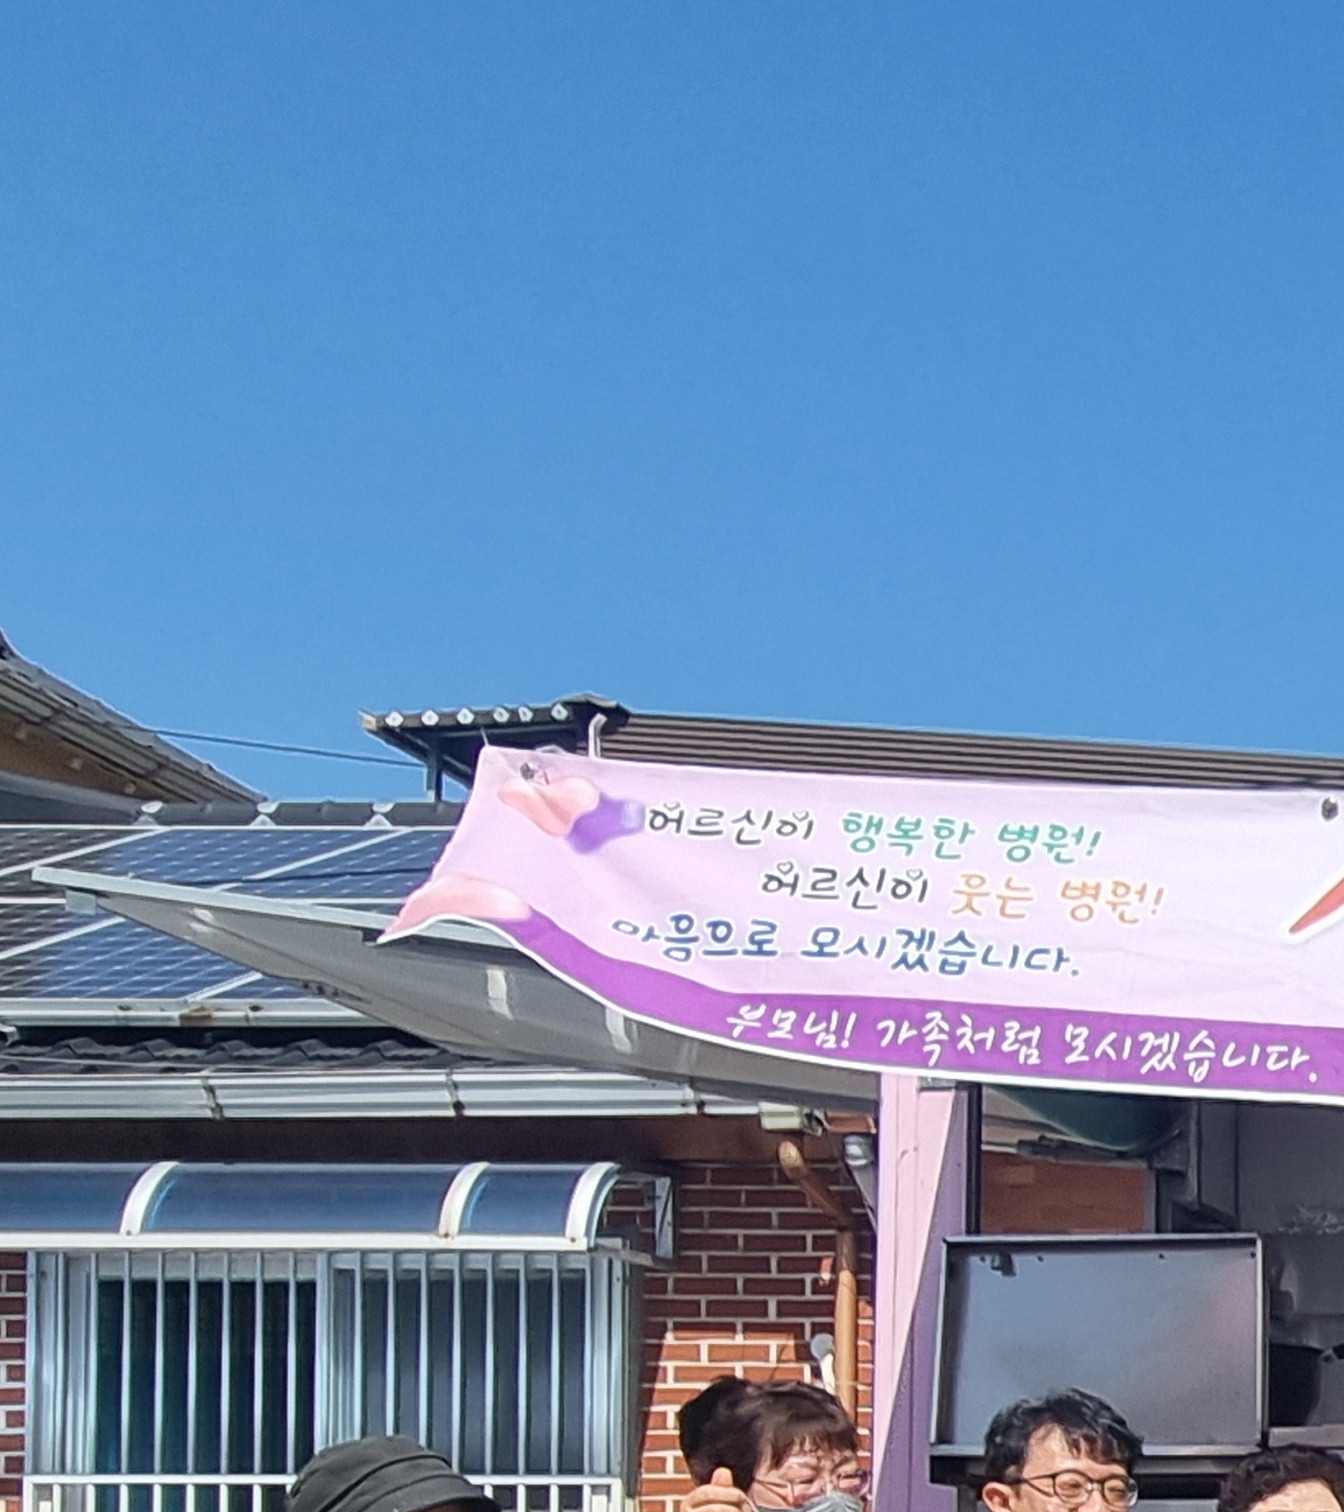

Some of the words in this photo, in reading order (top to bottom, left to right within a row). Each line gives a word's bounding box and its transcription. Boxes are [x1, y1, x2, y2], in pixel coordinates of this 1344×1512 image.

[648, 801, 814, 846] 어르신이
[841, 811, 974, 858] 행복한
[996, 822, 1102, 865] 병원!
[760, 860, 930, 910] 어르신이
[951, 871, 1035, 917] 웃는
[1059, 879, 1164, 924] 병원!
[800, 926, 1081, 977] 모시겠습니다.
[726, 1004, 856, 1051] 부모님!
[876, 1018, 1043, 1066] 가족처럼
[1065, 1026, 1319, 1083] 모시겠습니다.
